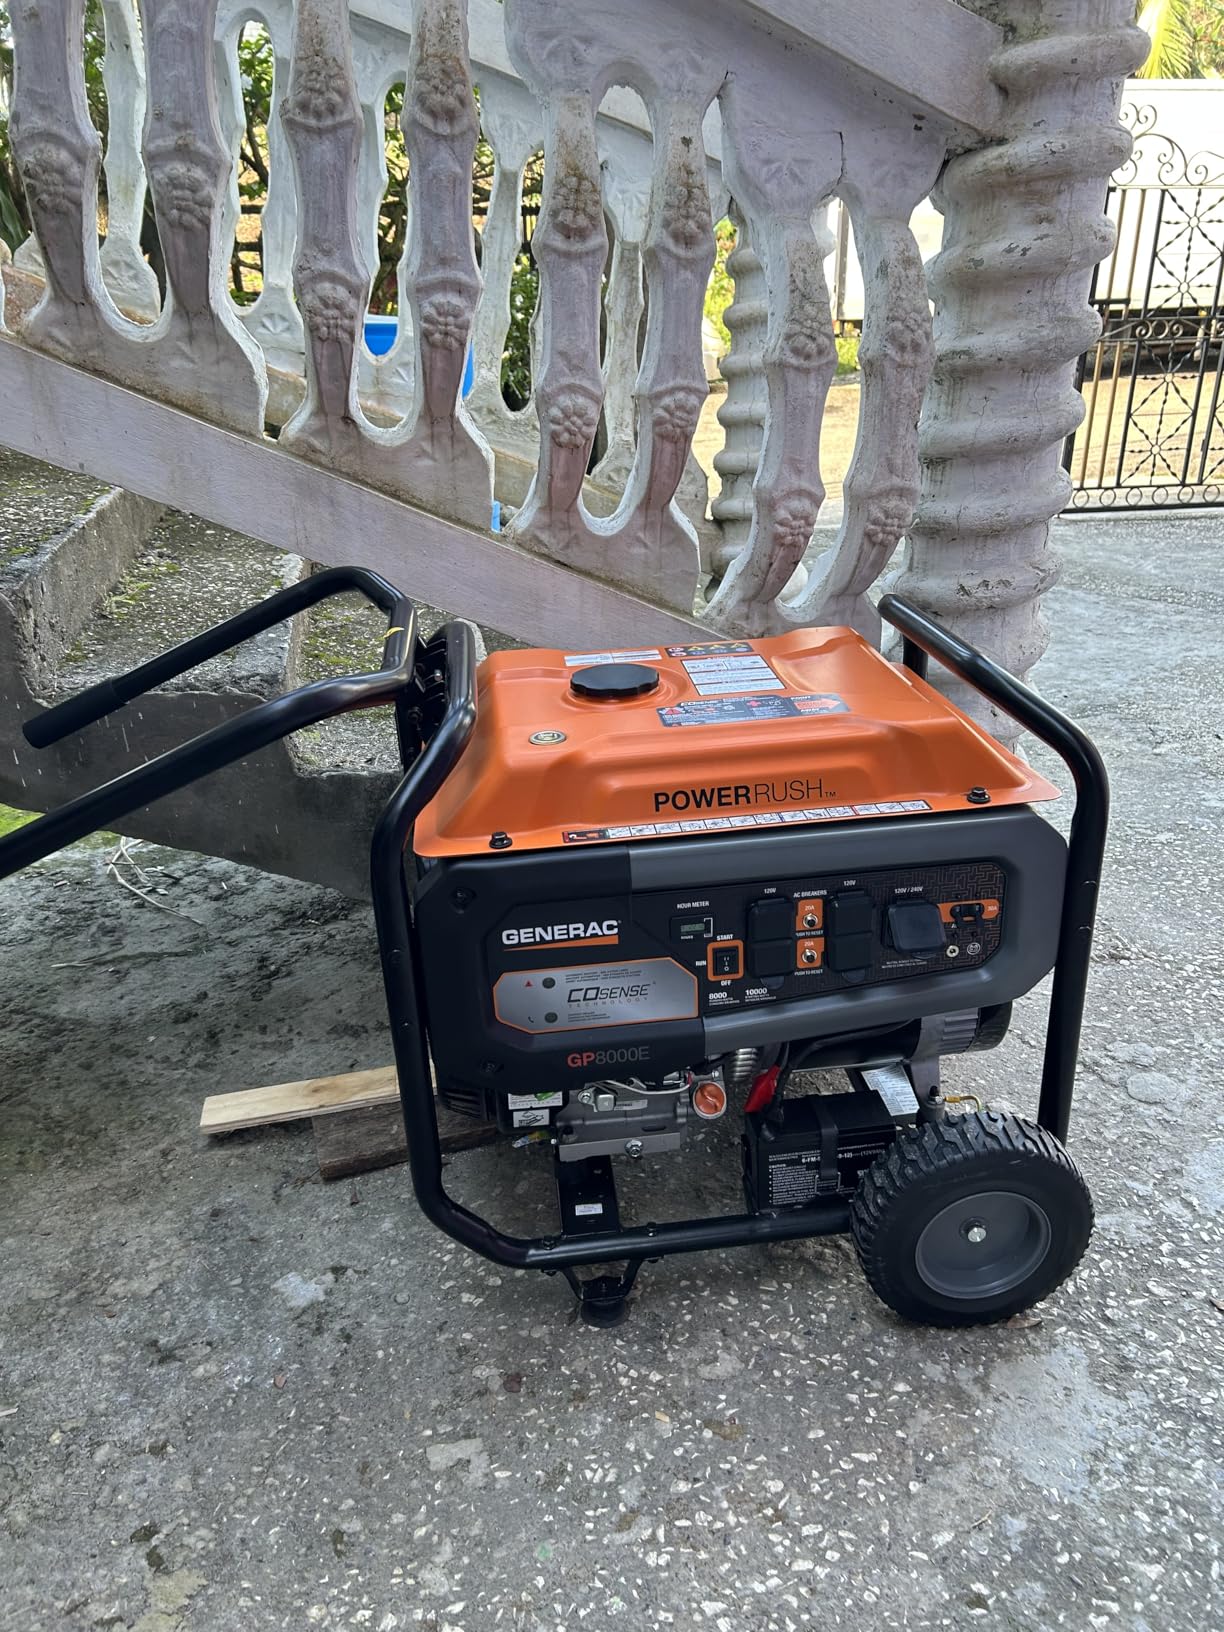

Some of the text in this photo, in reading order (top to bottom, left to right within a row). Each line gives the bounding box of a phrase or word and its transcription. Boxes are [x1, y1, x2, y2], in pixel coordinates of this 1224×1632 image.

[654, 778, 822, 812] POWERRUSH
[502, 920, 619, 945] GENERAC
[708, 992, 728, 1000] 8000
[745, 988, 768, 996] 10000
[567, 1046, 650, 1068] GP8000E
